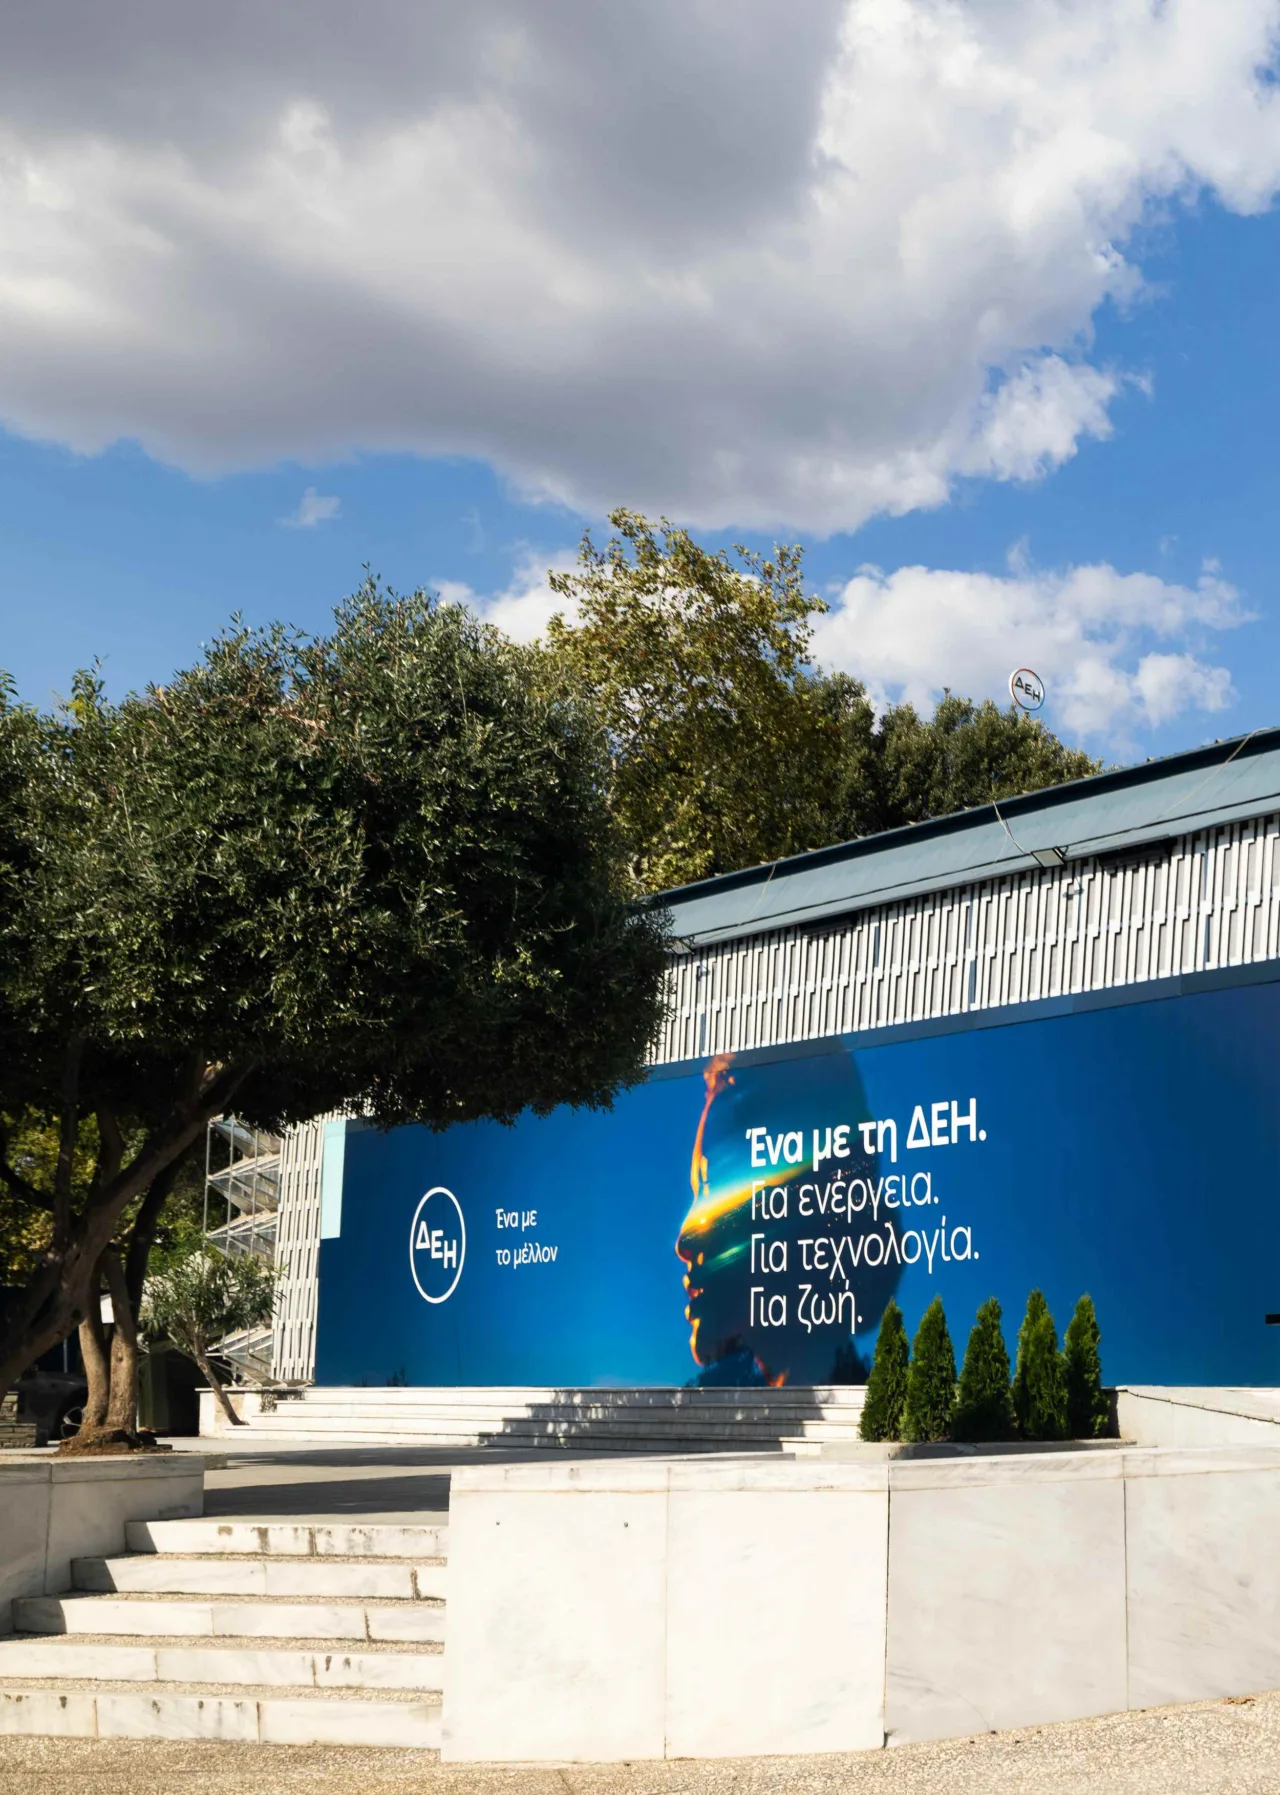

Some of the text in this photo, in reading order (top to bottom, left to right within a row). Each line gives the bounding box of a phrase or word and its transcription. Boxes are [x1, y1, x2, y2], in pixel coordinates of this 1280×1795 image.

[1015, 676, 1041, 703] ΔΕΗ
[745, 1097, 988, 1172] Ένα με τη ΔΕΗ.
[495, 1208, 538, 1233] Ένα με
[751, 1169, 940, 1224] Για ενέργεια.
[415, 1220, 457, 1269] ΔΕΗ
[495, 1241, 559, 1270] το μέλλον
[750, 1215, 980, 1281] Για τεχνολογία.
[750, 1279, 863, 1335] Για ζωή.
